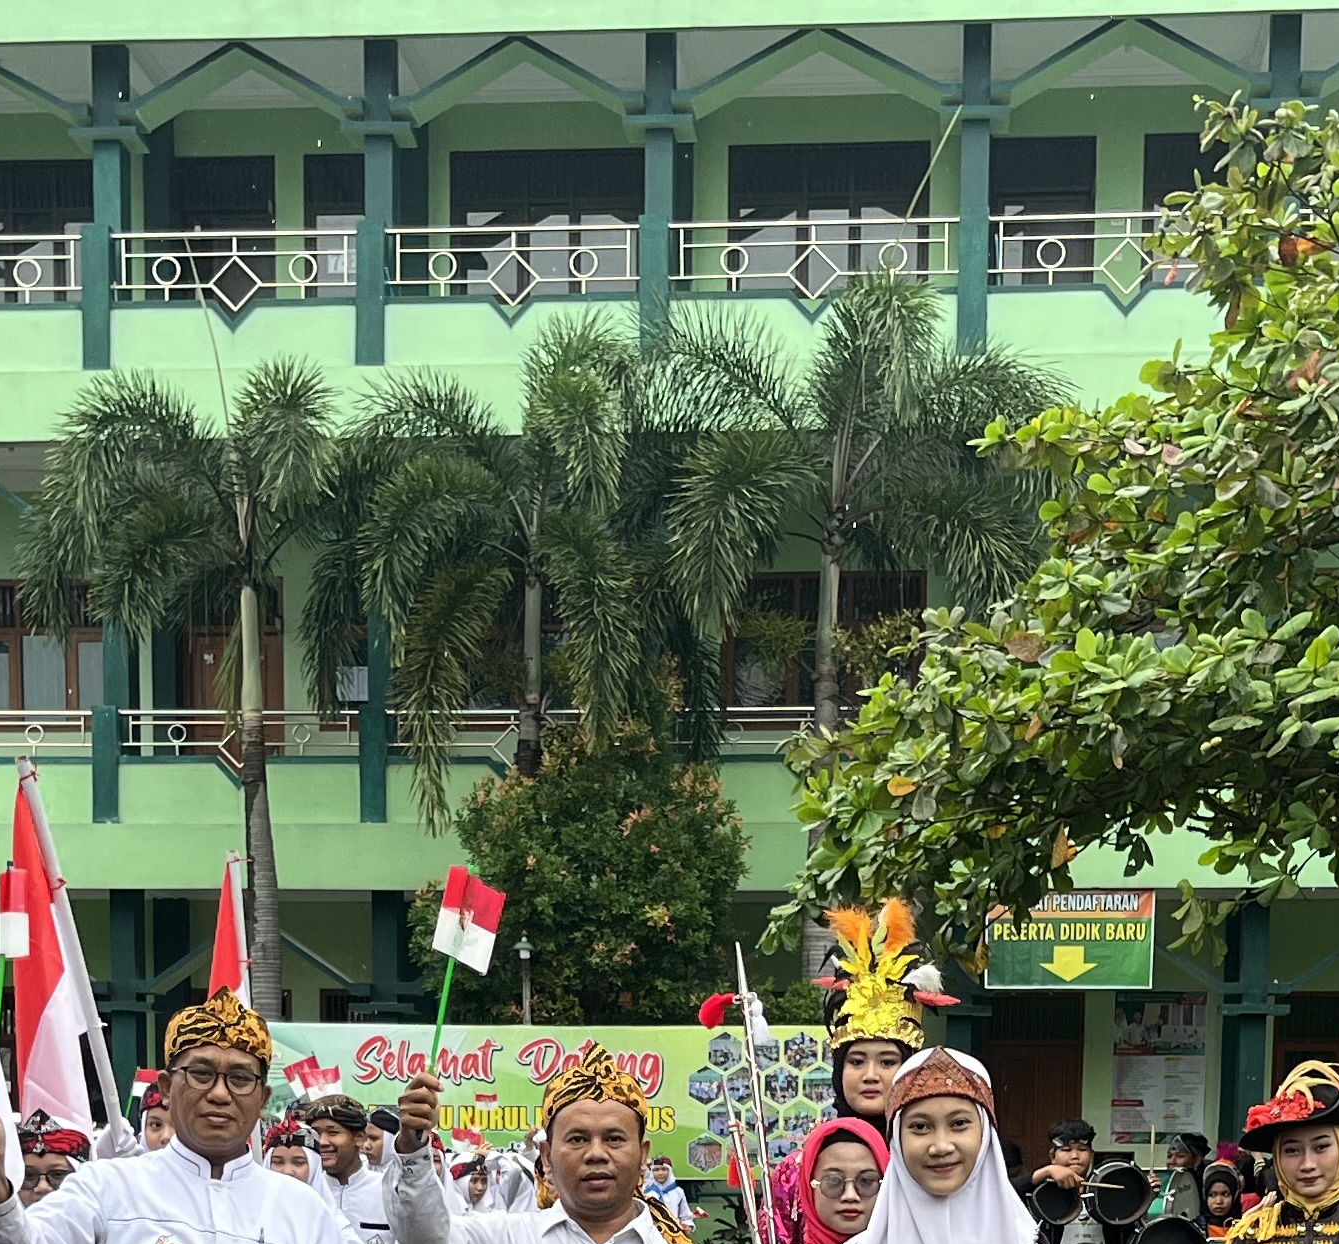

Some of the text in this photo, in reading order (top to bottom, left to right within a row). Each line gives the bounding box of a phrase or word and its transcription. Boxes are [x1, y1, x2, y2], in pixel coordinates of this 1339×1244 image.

[1052, 893, 1139, 911] PENDAFTARAN
[1059, 922, 1102, 941] DIDIK
[1105, 922, 1147, 941] BARU
[353, 1035, 664, 1098] Selamat Datng
[459, 1105, 530, 1131] NURUL
